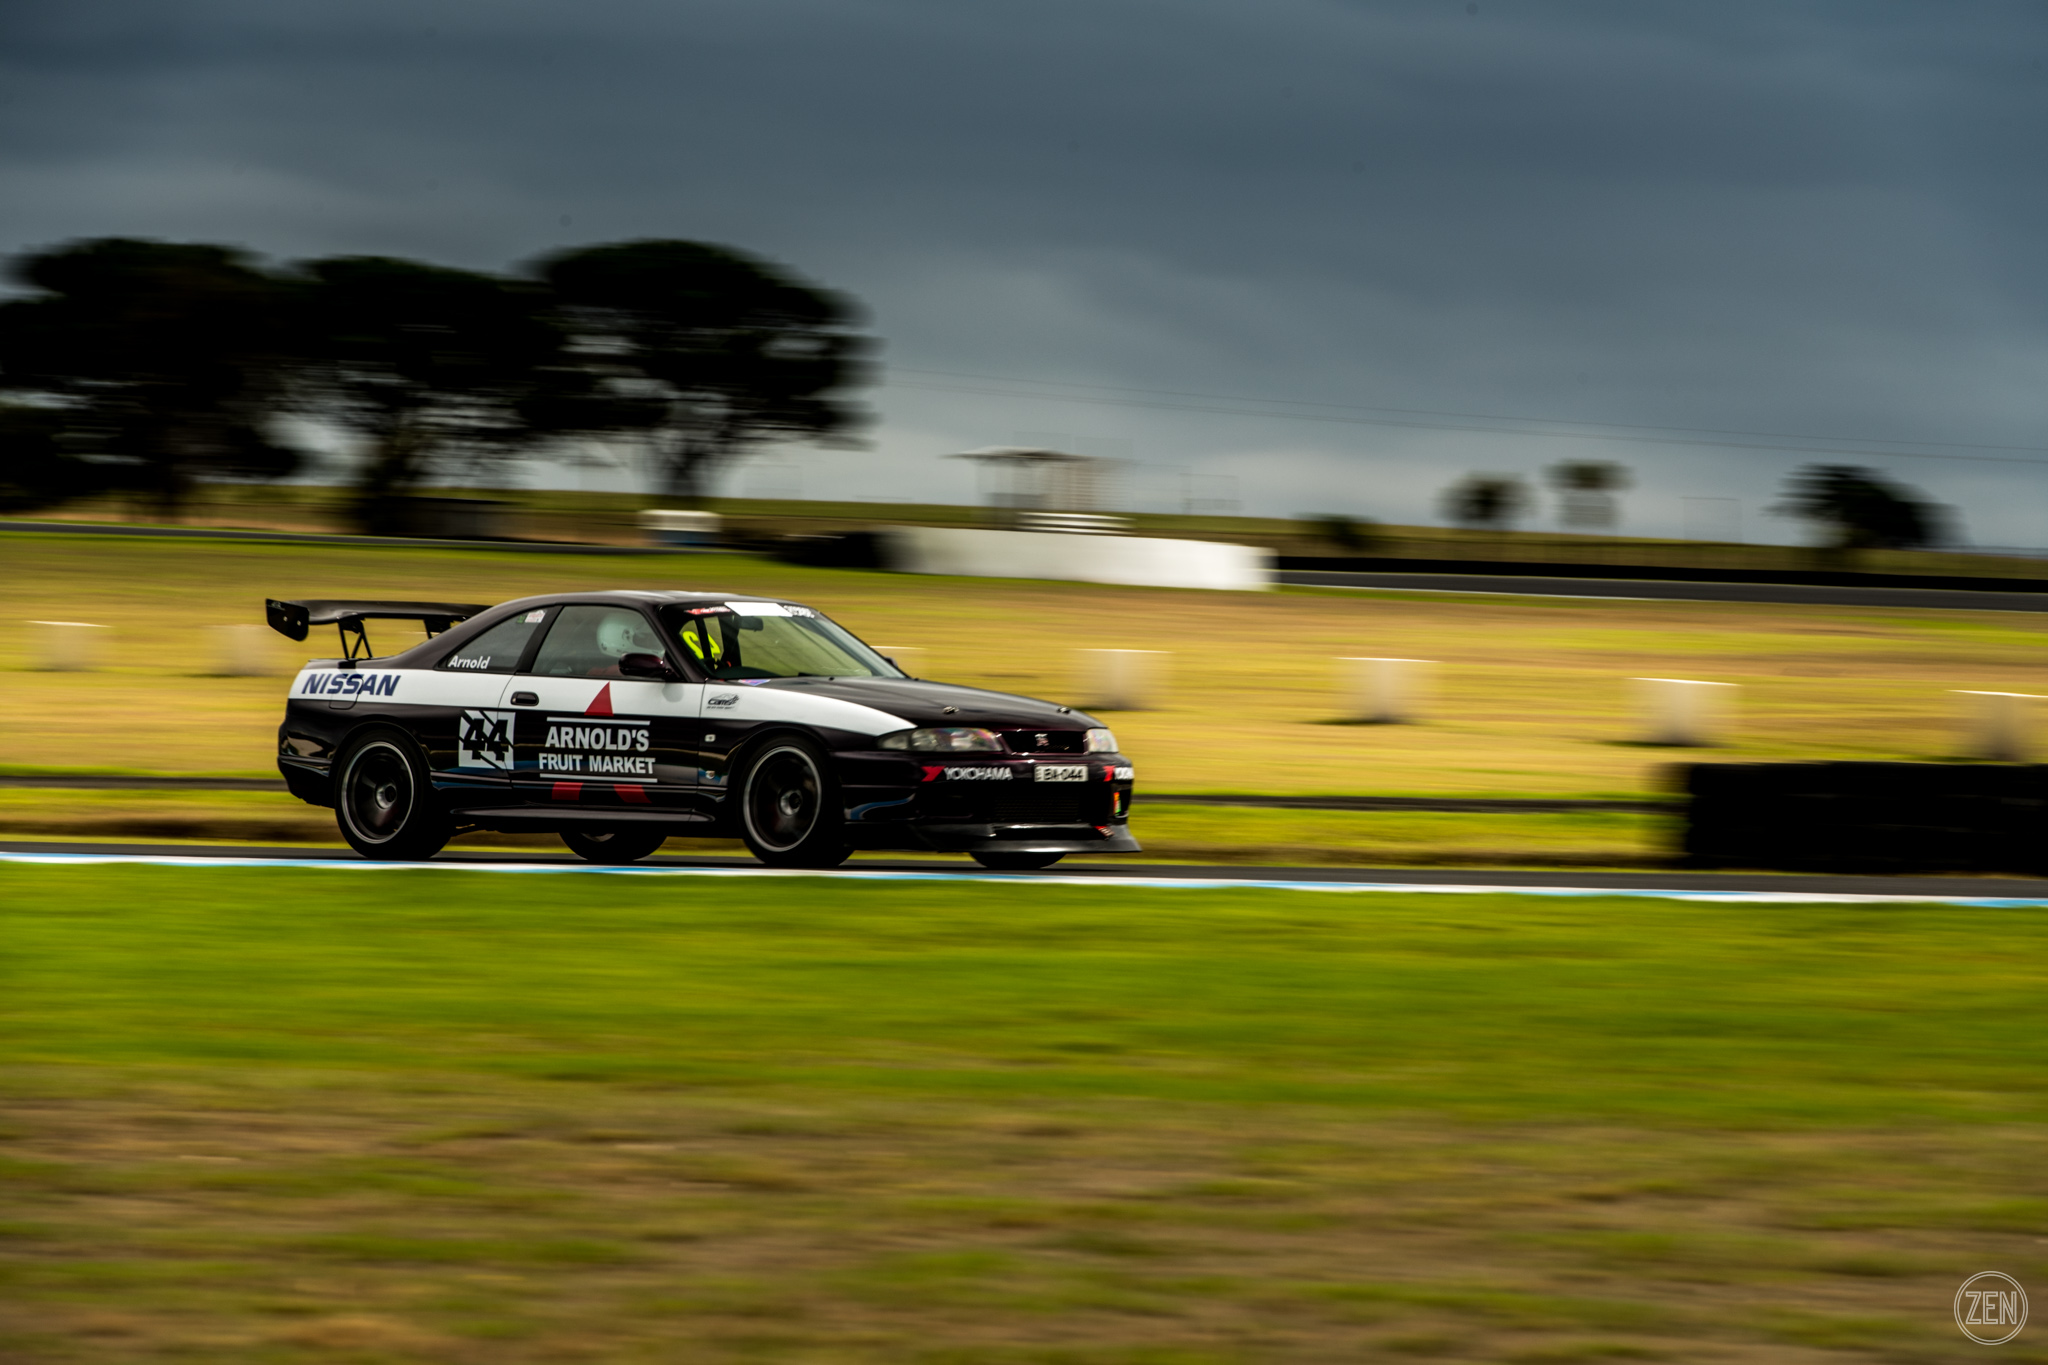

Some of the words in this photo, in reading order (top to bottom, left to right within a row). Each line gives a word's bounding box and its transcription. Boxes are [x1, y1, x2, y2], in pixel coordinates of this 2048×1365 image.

[447, 655, 491, 670] Arnold
[301, 673, 402, 697] NISSAN
[462, 717, 511, 762] 44
[544, 726, 650, 752] ARNOLD'S
[538, 753, 584, 772] FRUIT
[588, 755, 656, 774] MARKET
[944, 766, 1014, 781] YOKOHAMA
